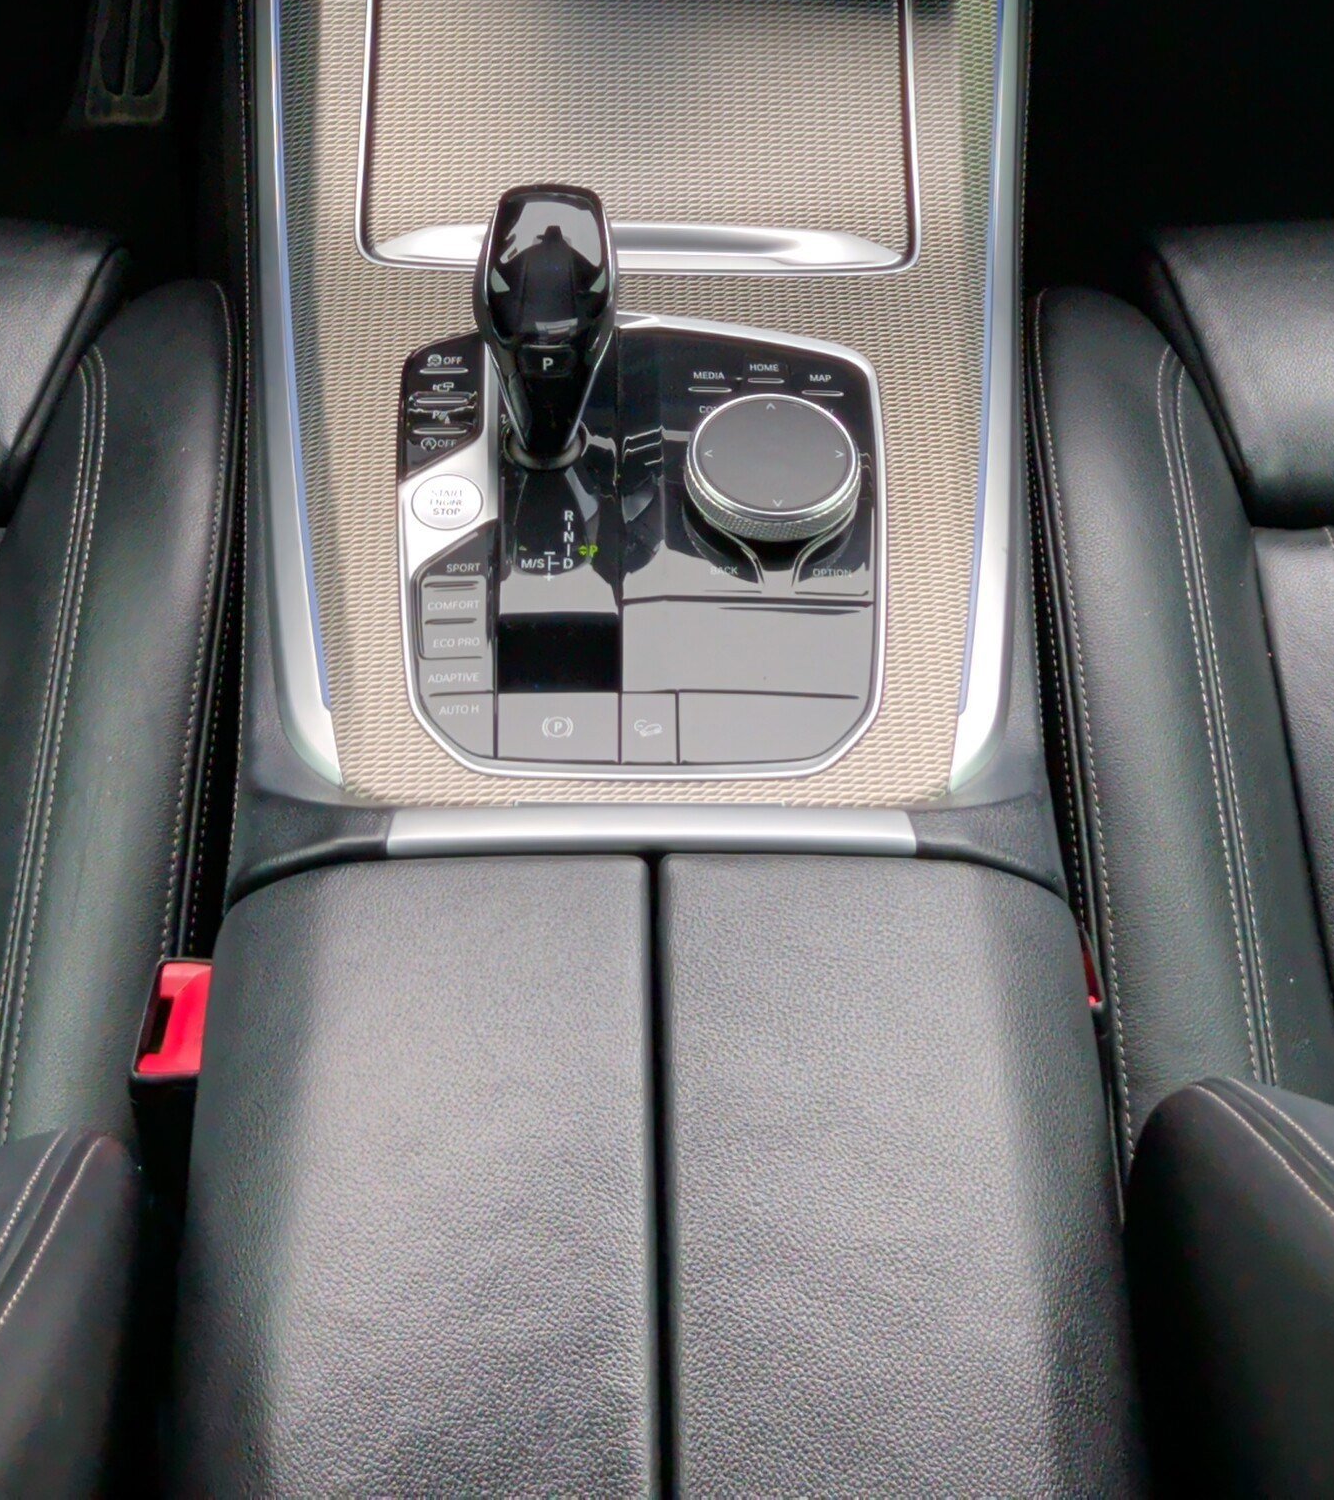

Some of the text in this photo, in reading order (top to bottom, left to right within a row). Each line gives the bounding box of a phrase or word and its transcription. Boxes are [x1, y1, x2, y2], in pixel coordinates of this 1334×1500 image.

[443, 356, 463, 365] OFF
[542, 357, 554, 371] P
[749, 363, 780, 372] HOME
[693, 371, 726, 380] MEDIA
[809, 374, 832, 382] MAP
[438, 439, 457, 447] OFF
[432, 507, 461, 516] STOP
[564, 509, 574, 521] R
[563, 531, 575, 543] N
[446, 562, 481, 573] SPORT
[520, 558, 545, 569] M/S
[563, 557, 574, 569] D
[710, 565, 739, 576] BACK
[812, 567, 853, 578] OPTION
[427, 600, 480, 611] COMFORT
[432, 637, 481, 648] ECO PRO
[427, 672, 481, 683] ADAPTIVE
[438, 704, 480, 716] AUTO H
